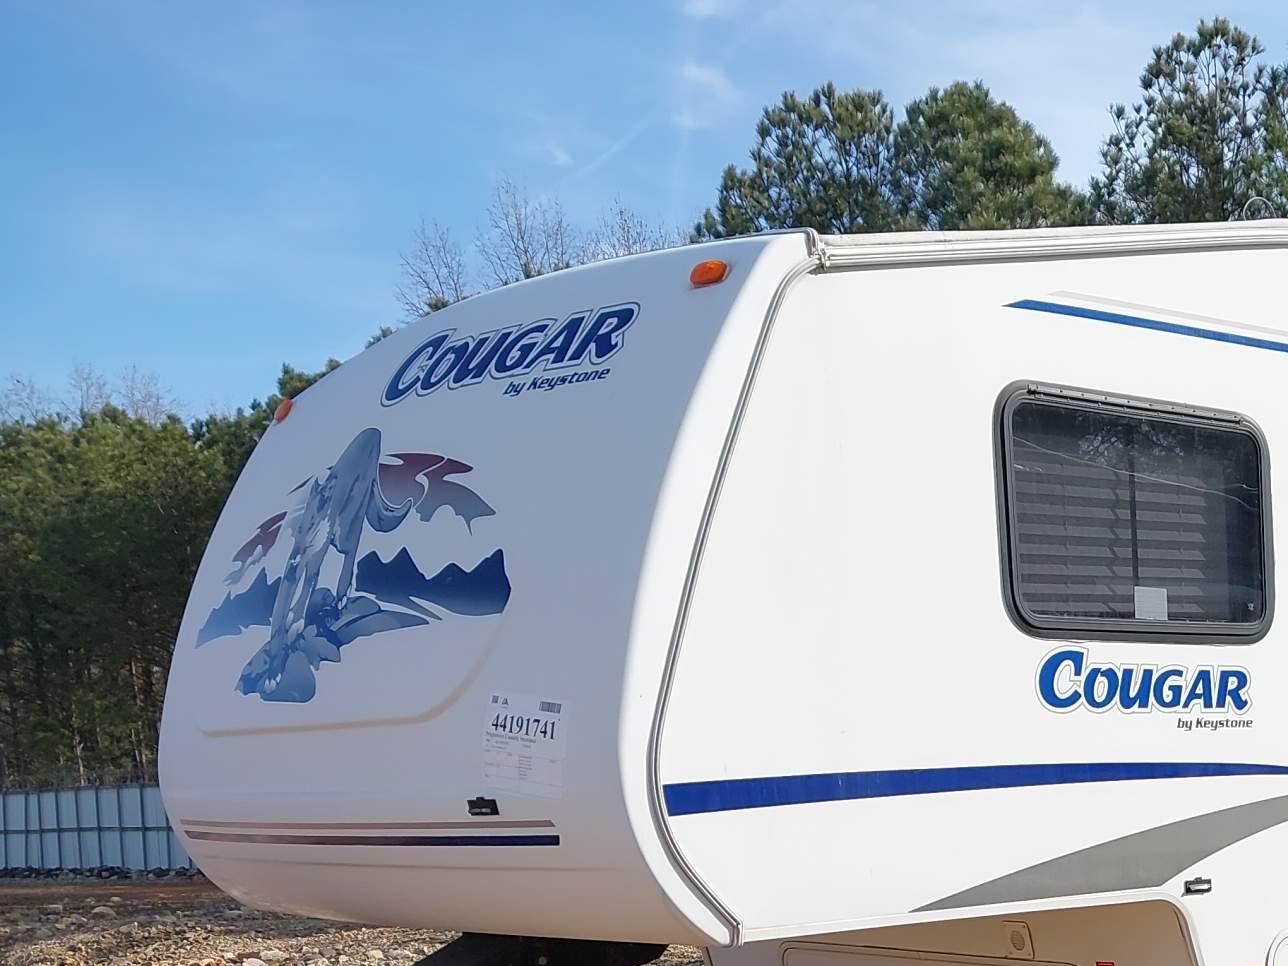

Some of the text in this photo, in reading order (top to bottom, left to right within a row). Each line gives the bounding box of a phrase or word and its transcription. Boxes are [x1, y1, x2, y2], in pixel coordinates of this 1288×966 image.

[383, 305, 637, 404] COUGAR
[502, 368, 611, 397] by Keystone
[1037, 648, 1249, 712] COUGAR
[491, 713, 556, 740] 44191741
[1177, 717, 1253, 732] by Keystone
